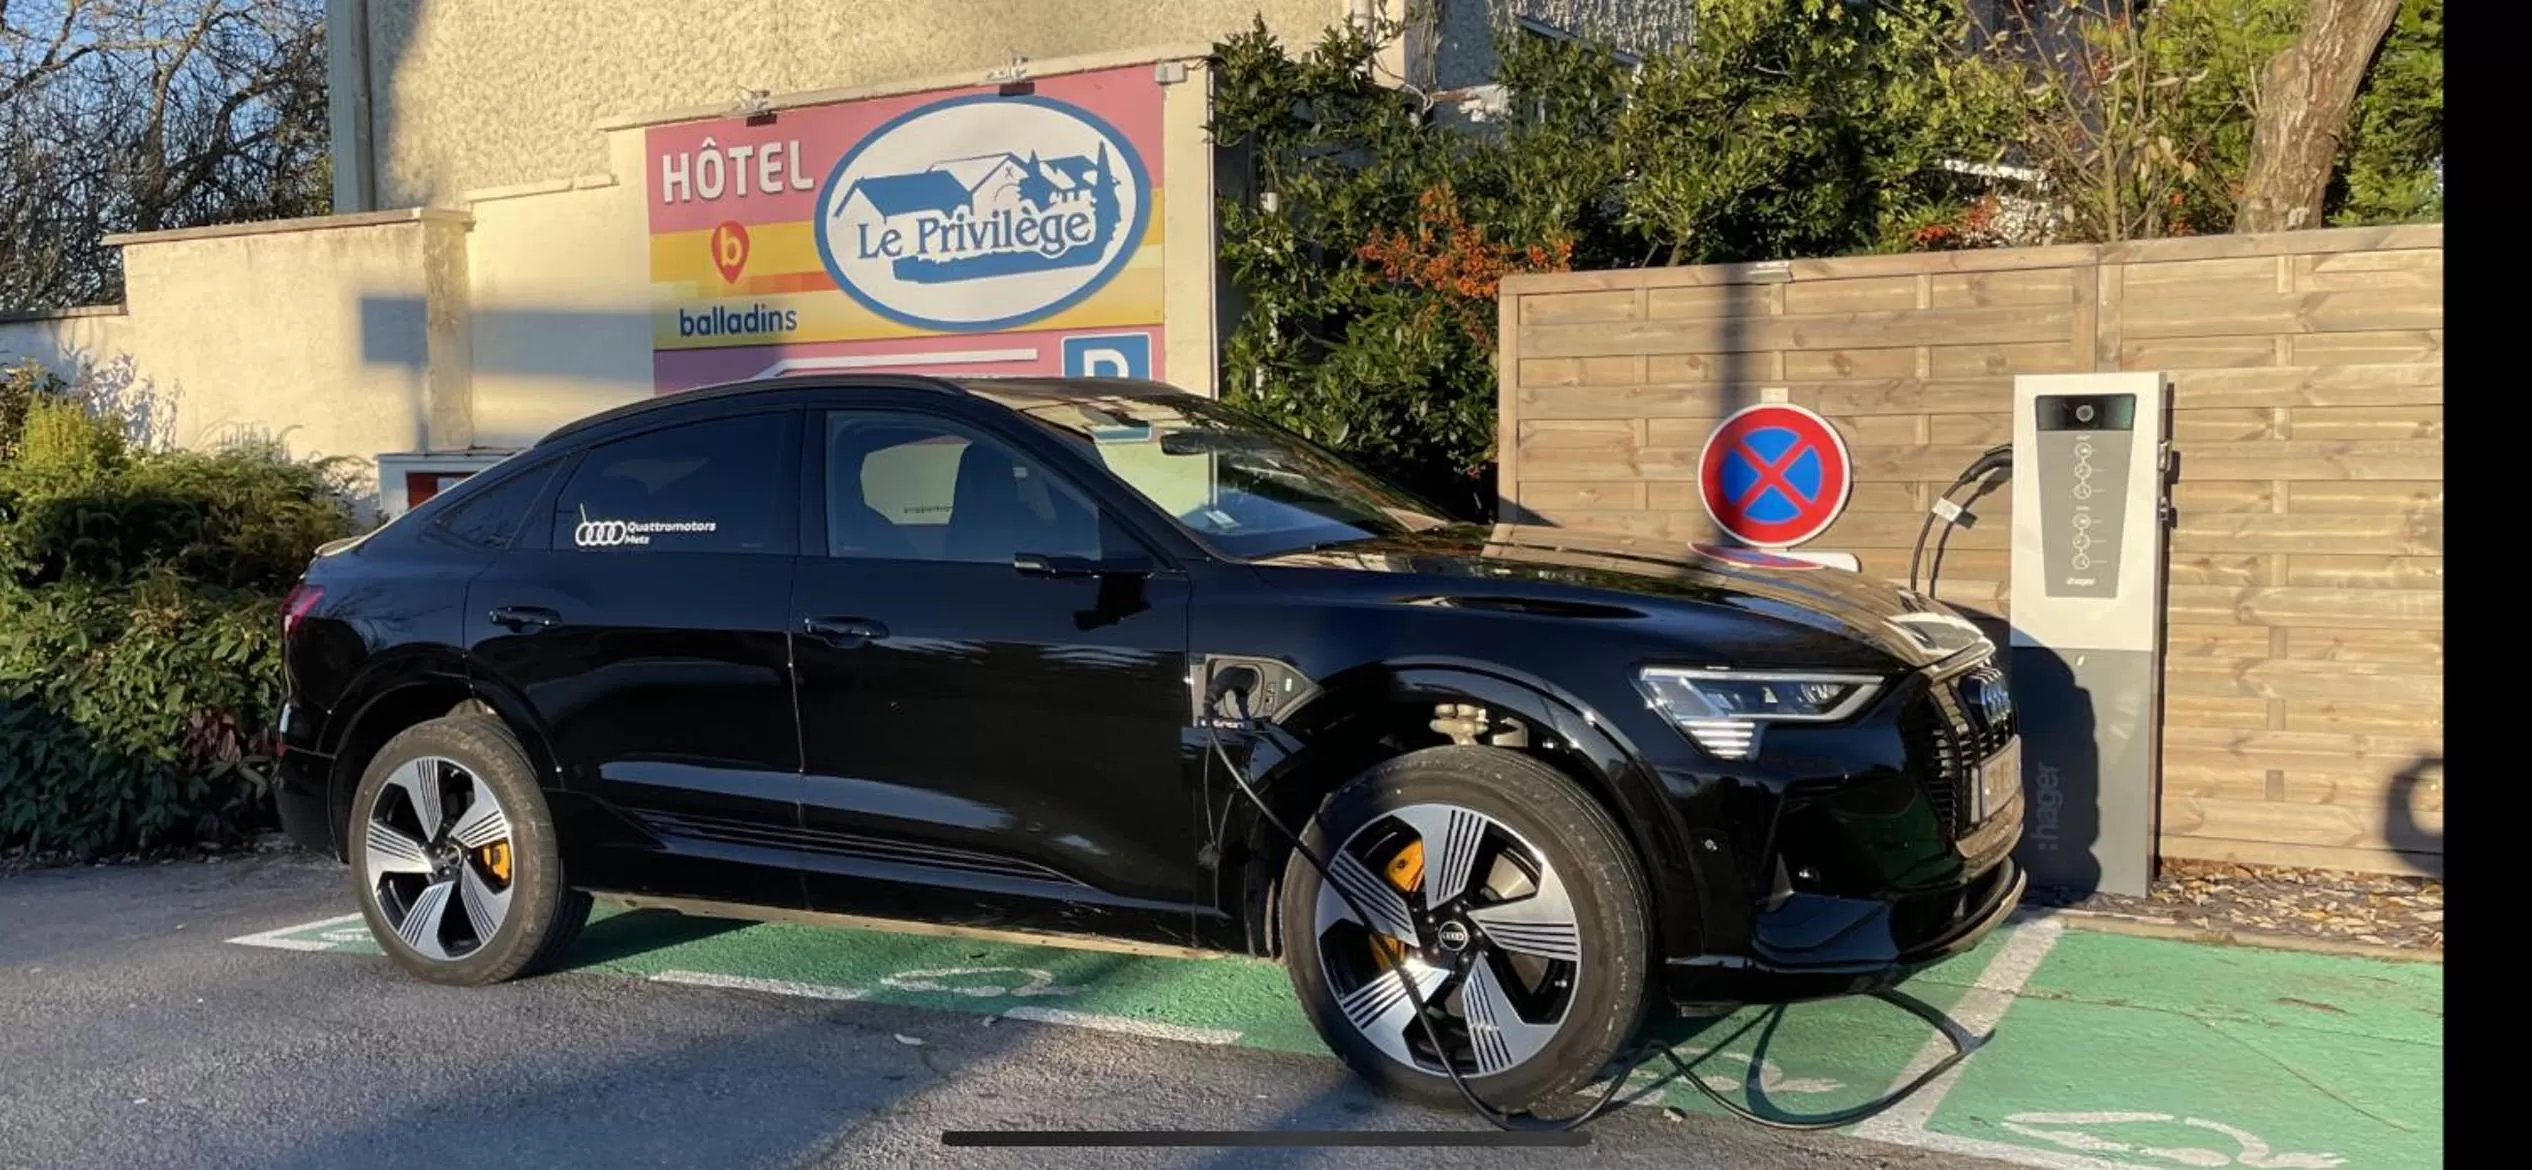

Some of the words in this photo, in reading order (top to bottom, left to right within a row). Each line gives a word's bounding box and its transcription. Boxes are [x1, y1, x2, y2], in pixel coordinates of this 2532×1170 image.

[662, 133, 816, 203] HÔTEL
[719, 226, 744, 267] b
[857, 223, 904, 259] Le
[917, 206, 1091, 255] Privilège
[679, 303, 798, 337] balladins
[627, 521, 717, 534] Quattromotors
